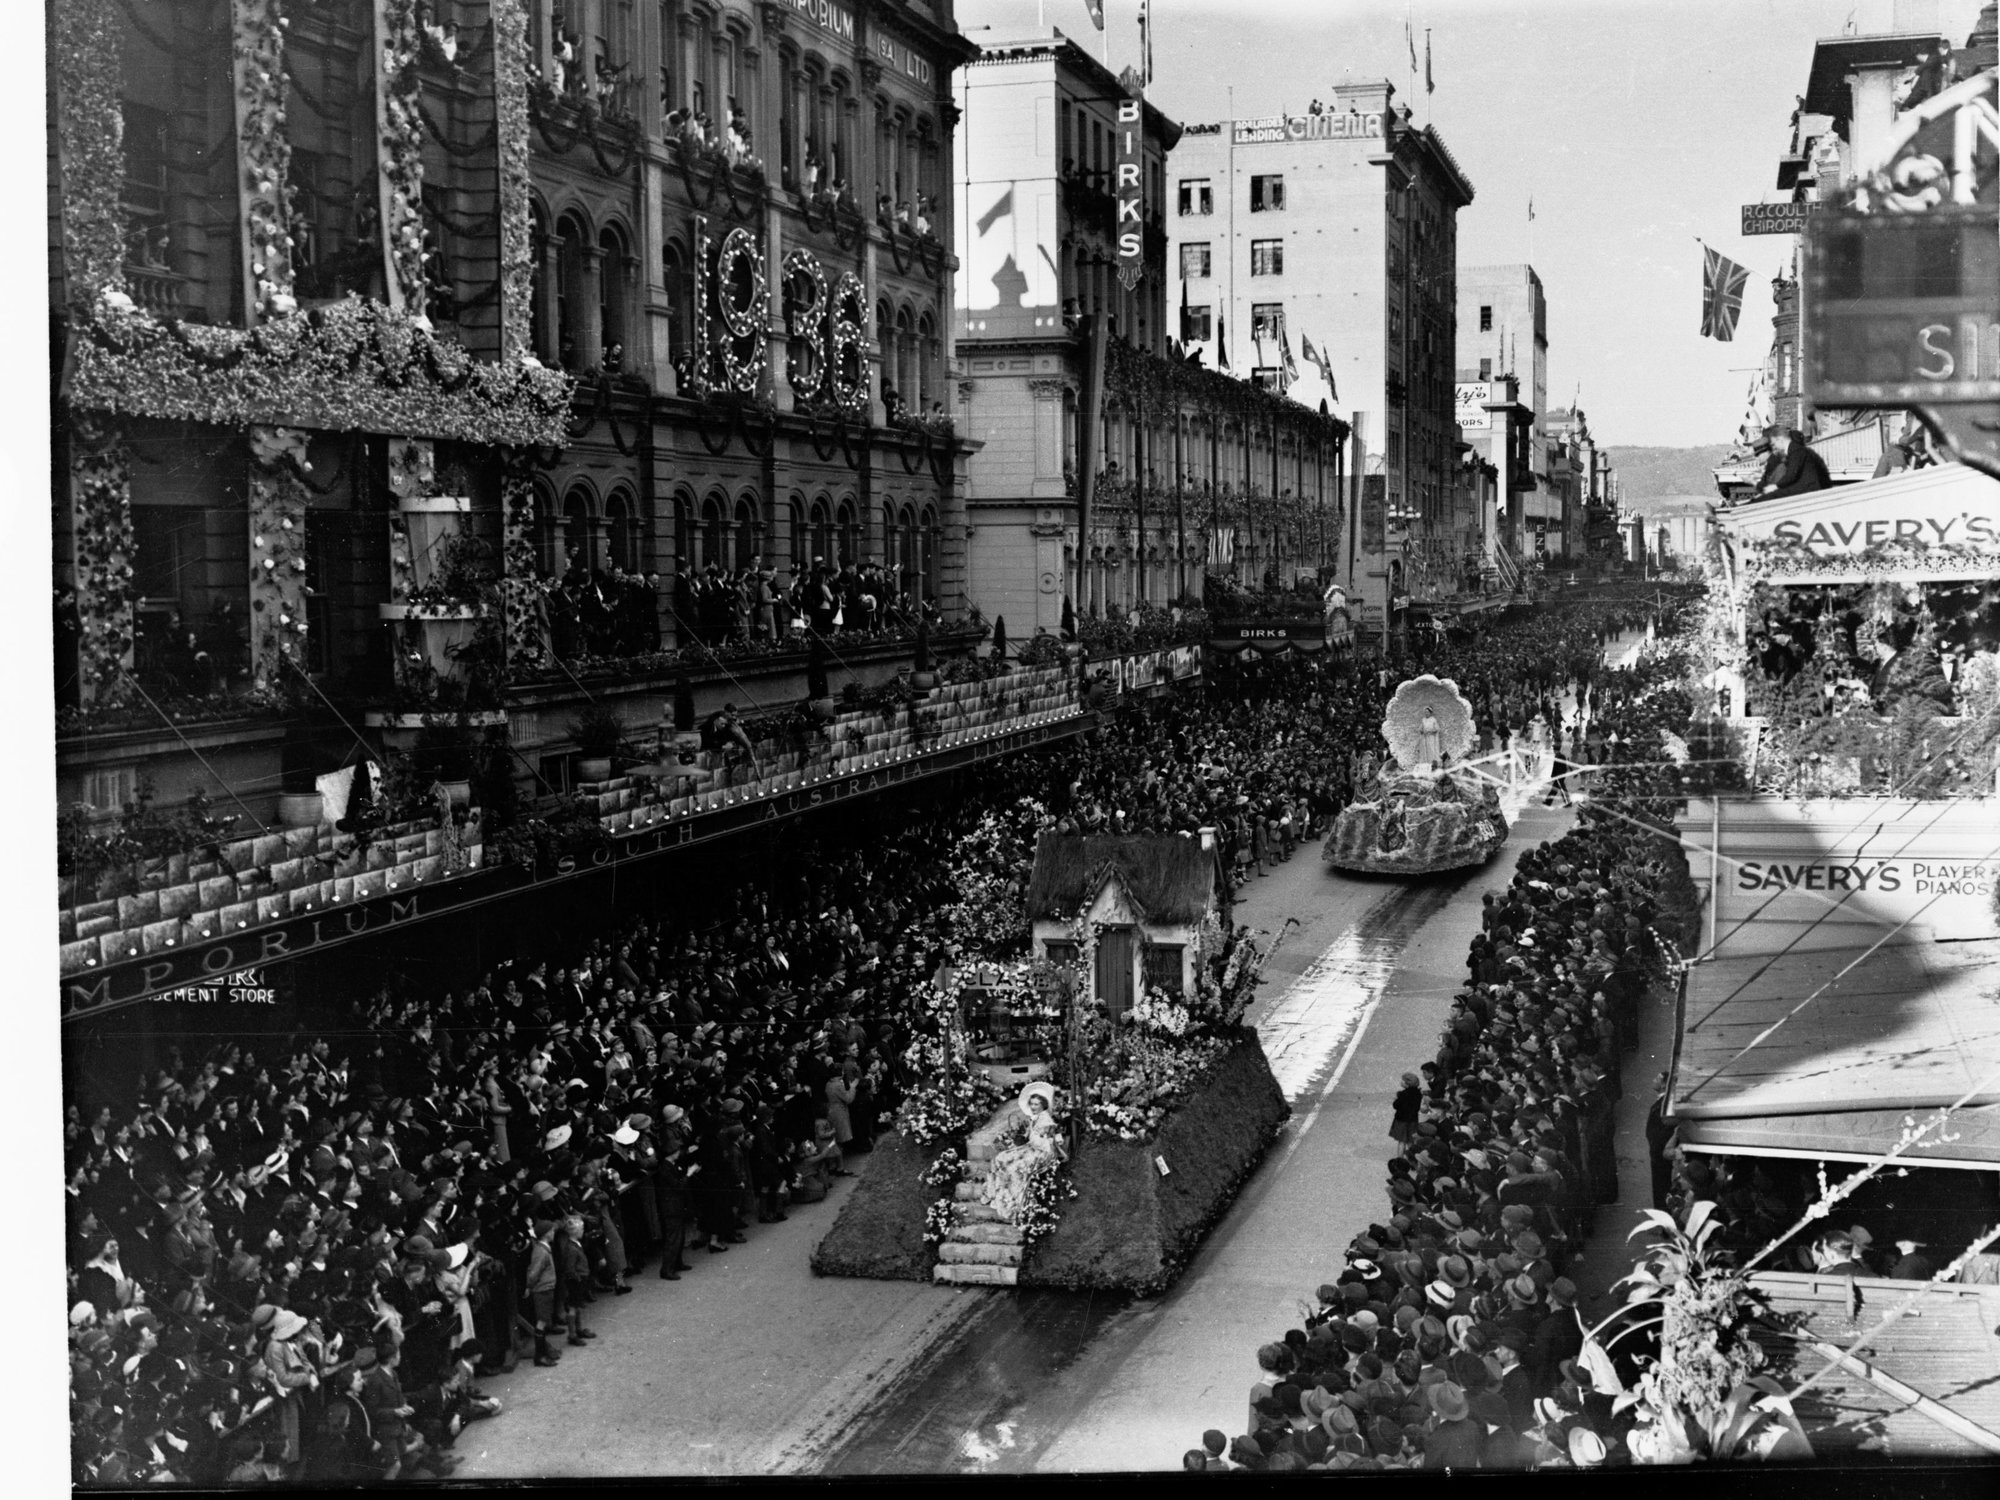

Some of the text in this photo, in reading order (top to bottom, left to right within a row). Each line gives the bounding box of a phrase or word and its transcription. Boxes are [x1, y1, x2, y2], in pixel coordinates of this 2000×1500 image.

[1235, 129, 1285, 143] LEADING
[1288, 114, 1383, 139] CINEMA
[1118, 102, 1140, 257] BIRKS
[694, 214, 873, 412] 1936
[1773, 512, 1995, 547] SAVERY'S
[1240, 628, 1287, 638] BIRKS
[1738, 861, 1901, 892] SAVERY'S
[1913, 863, 1986, 879] PLAYER
[1916, 880, 1990, 896] PIANOS
[229, 988, 276, 1004] STORE
